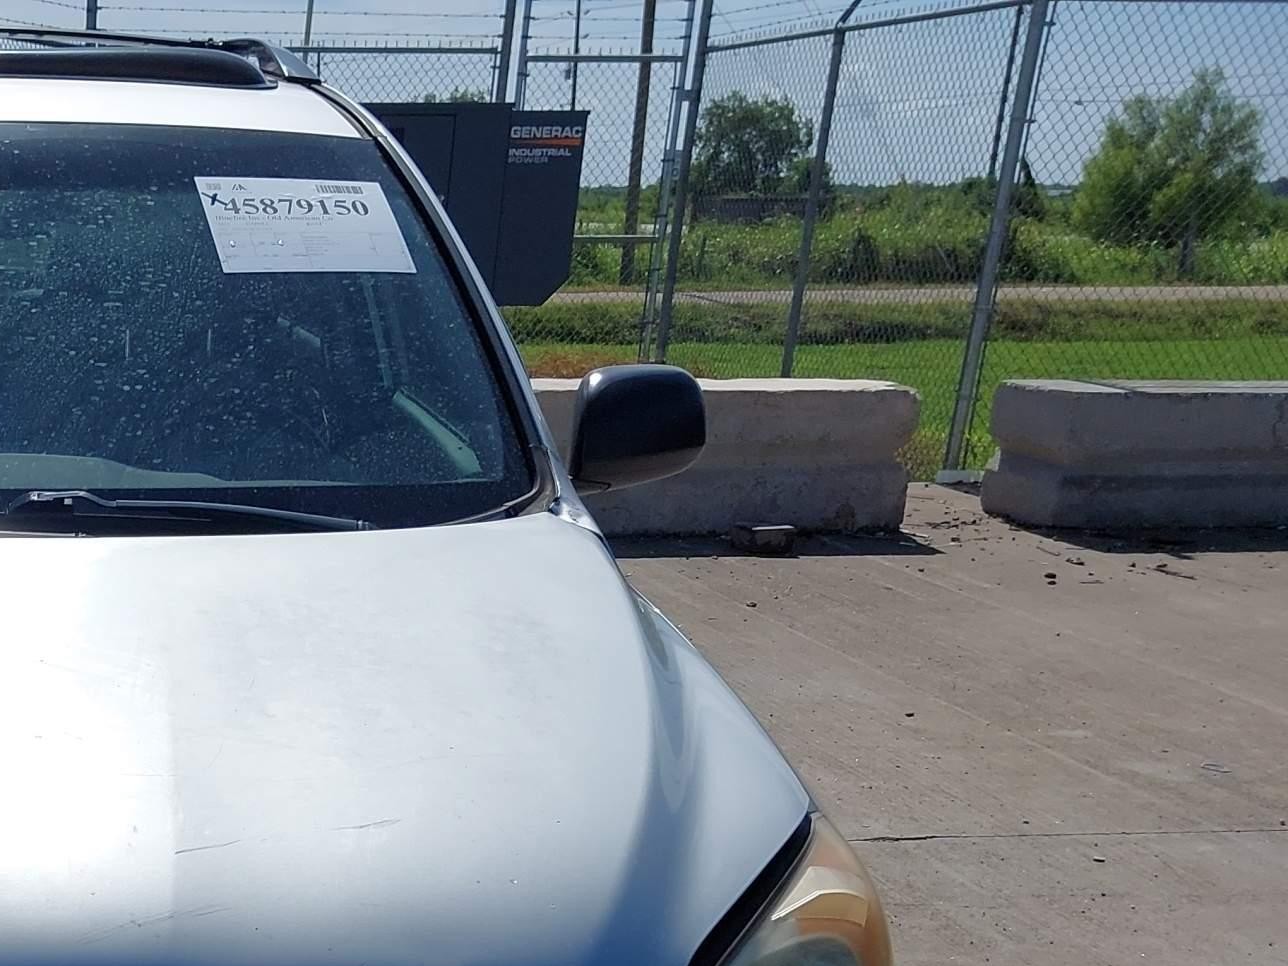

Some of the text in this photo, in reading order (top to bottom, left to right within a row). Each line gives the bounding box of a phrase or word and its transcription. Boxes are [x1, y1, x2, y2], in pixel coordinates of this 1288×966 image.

[510, 126, 583, 138] GENERAC
[508, 148, 572, 156] INDUSTRIAL
[508, 156, 549, 164] POWER
[223, 197, 369, 216] 45879150
